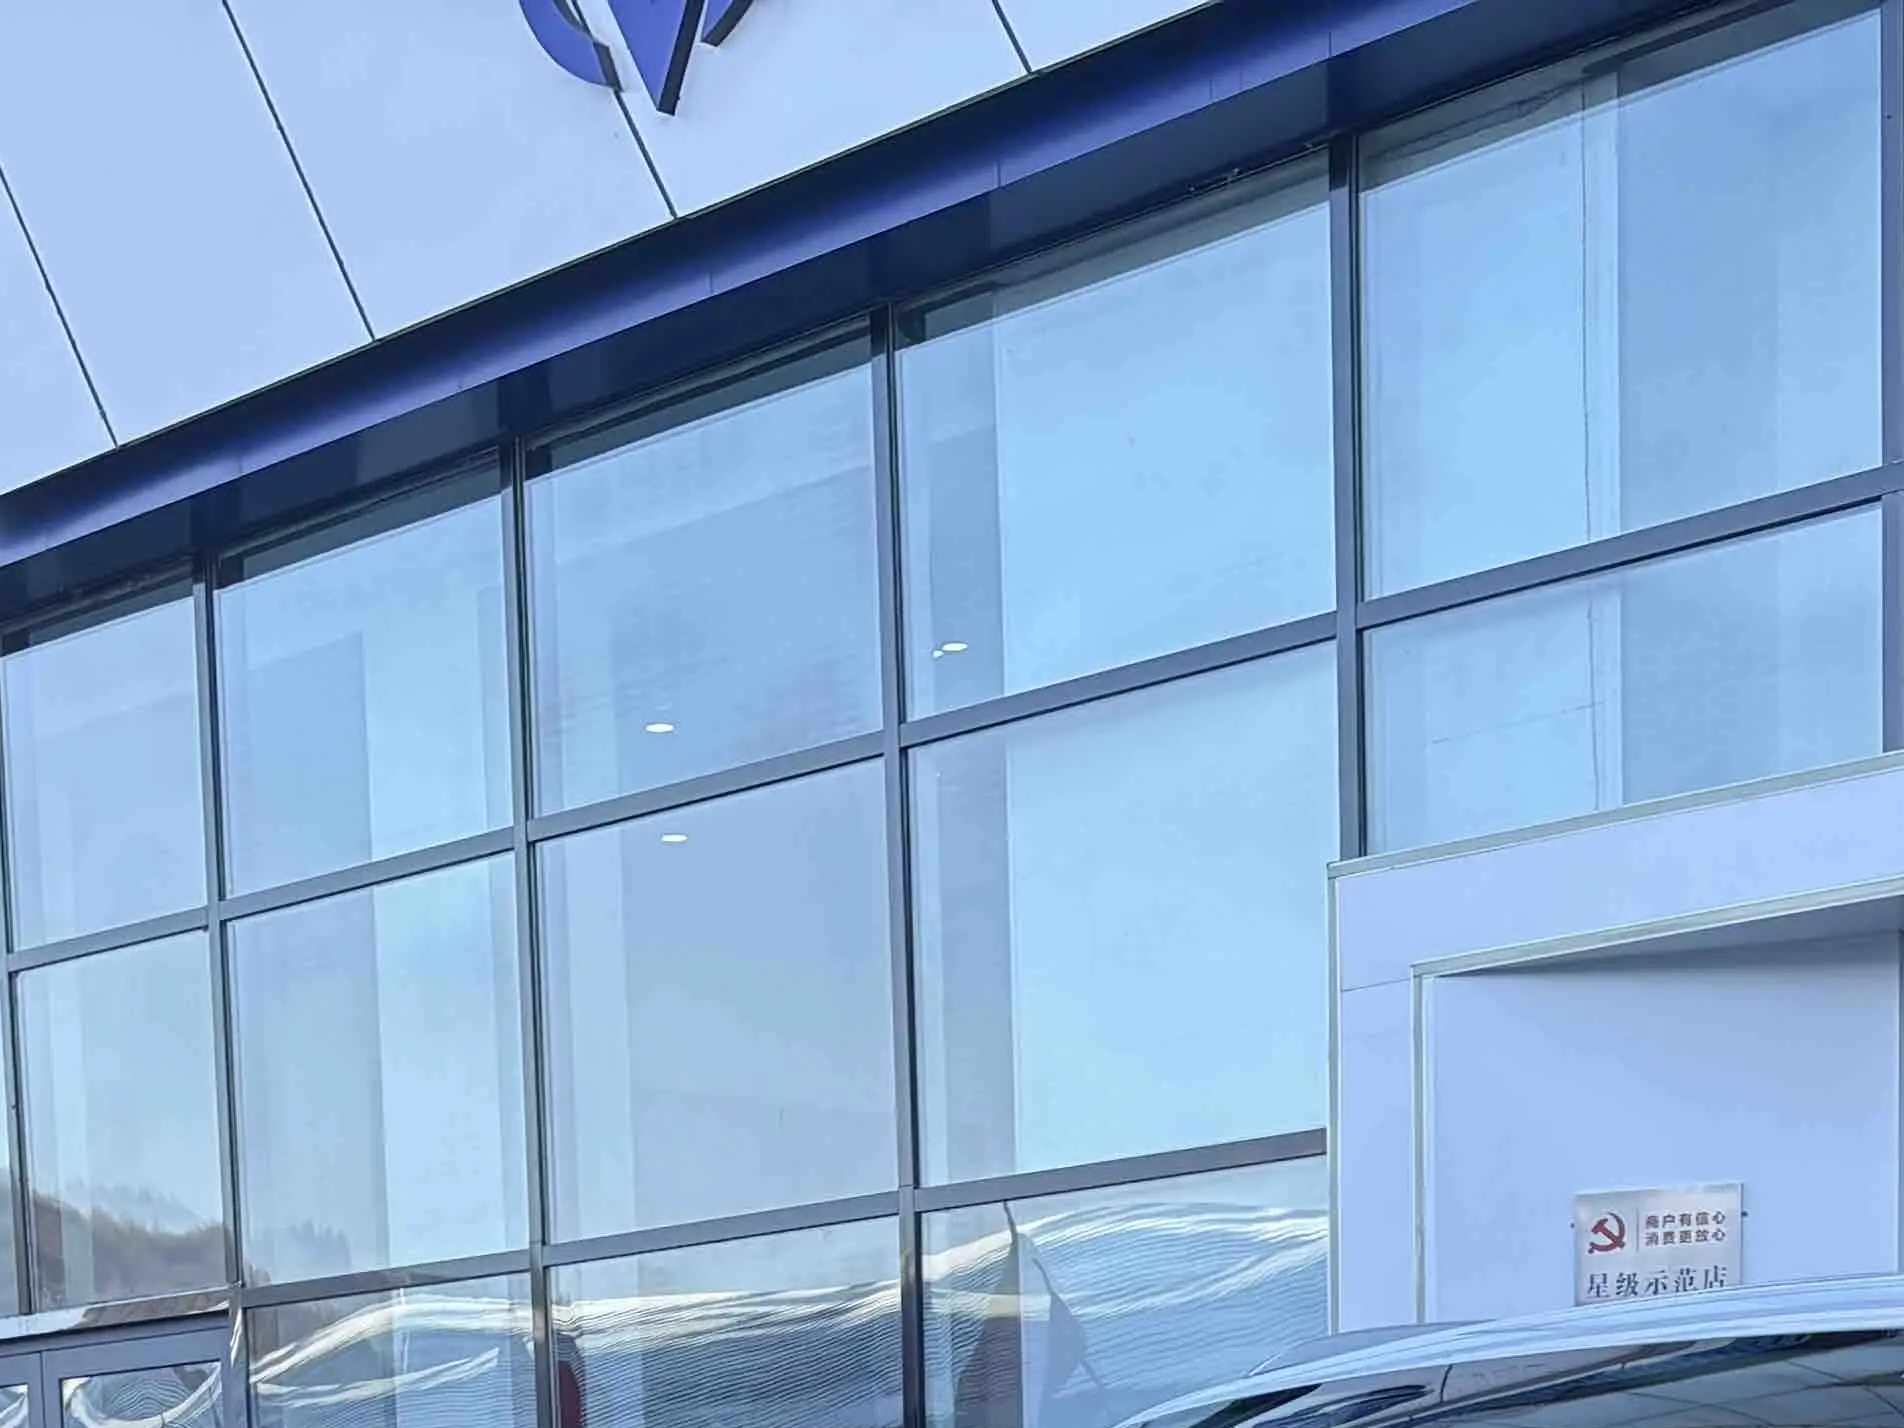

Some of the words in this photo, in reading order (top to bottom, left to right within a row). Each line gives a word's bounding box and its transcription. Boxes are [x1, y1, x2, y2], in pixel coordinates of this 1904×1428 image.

[1586, 1264, 1729, 1299] 星级示范店
